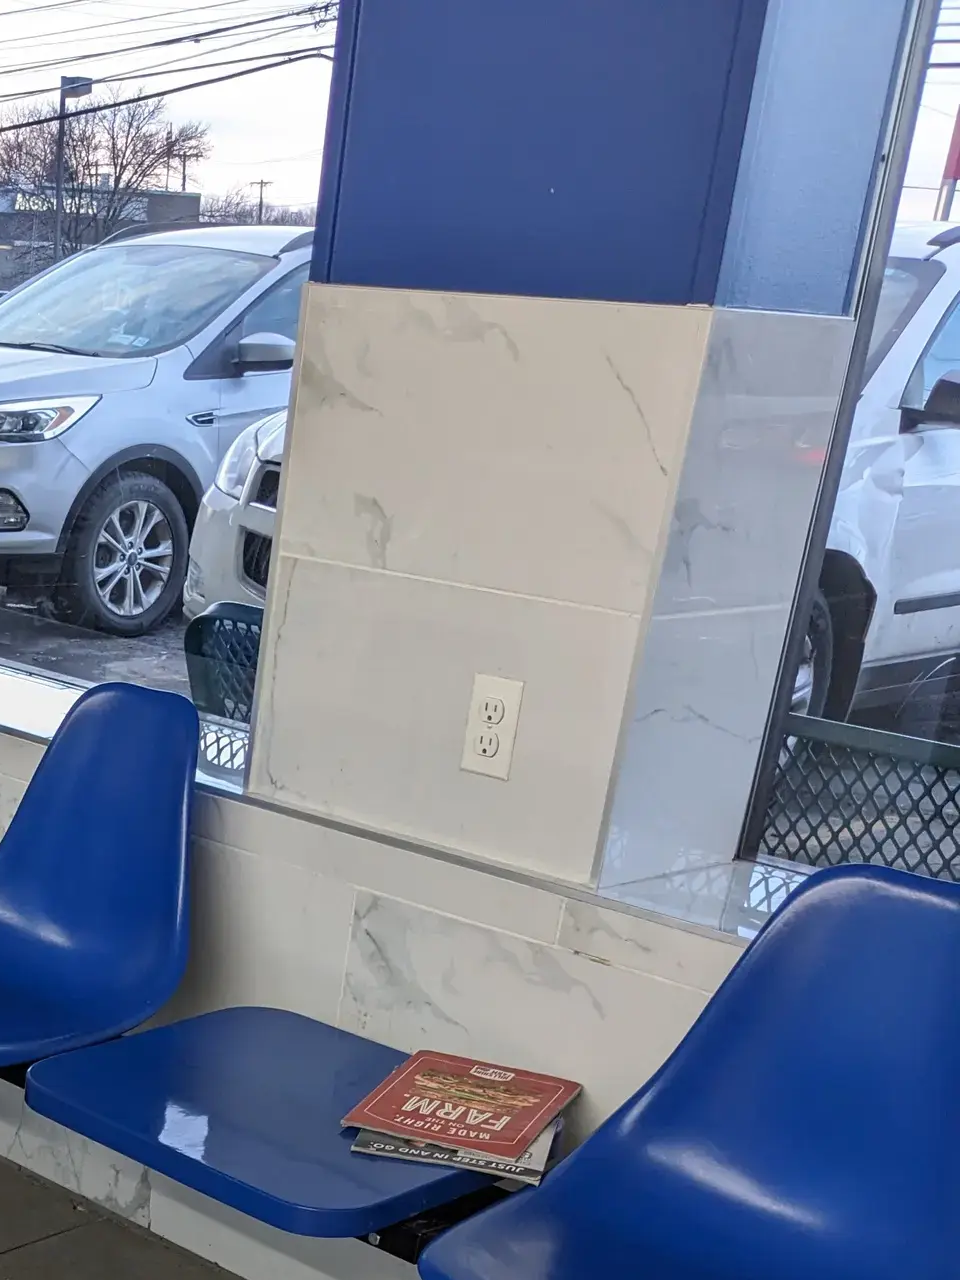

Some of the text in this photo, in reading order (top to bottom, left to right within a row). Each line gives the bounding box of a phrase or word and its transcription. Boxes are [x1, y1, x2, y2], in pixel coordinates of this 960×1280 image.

[393, 1114, 491, 1140] MADE RIGHT.
[401, 1094, 512, 1131] FARM.
[370, 1141, 525, 1173] JUST STEP IN AND GO.
